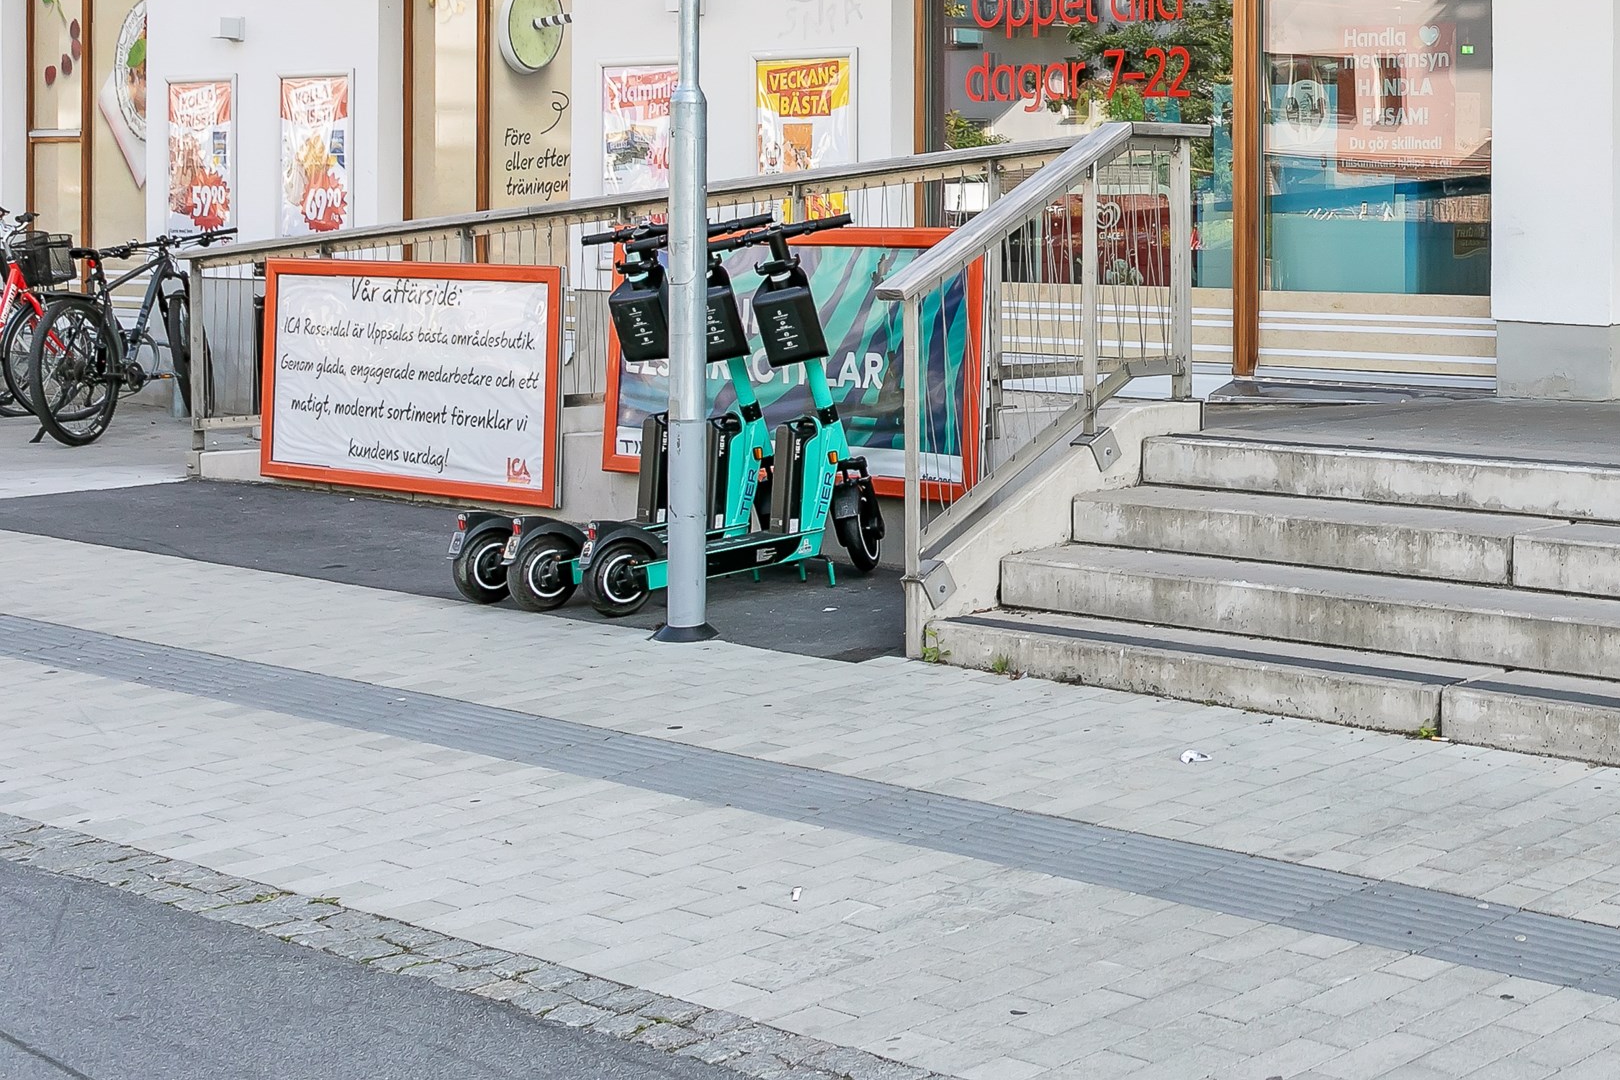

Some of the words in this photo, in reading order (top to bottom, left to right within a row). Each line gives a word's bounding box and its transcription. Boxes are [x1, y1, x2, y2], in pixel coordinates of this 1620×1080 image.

[1343, 27, 1407, 49] Handla
[1343, 49, 1383, 70] med
[1386, 47, 1450, 72] hänsyn
[769, 65, 839, 91] VECKANS
[964, 51, 1086, 113] dagar
[1358, 77, 1434, 97] HANDLA
[779, 92, 830, 116] BÄSTA
[504, 127, 532, 147] Före
[1349, 136, 1365, 150] Du
[1368, 136, 1389, 153] gör
[1391, 136, 1442, 150] skillnad!
[505, 150, 535, 172] eller
[536, 147, 571, 169] efter
[350, 277, 380, 303] Vår
[283, 316, 301, 334] ICA
[303, 317, 350, 337] Rosendal
[352, 323, 365, 339] är
[367, 321, 414, 346] Uppsalas
[418, 326, 449, 345] bästa
[451, 329, 536, 350] områdesbutik.
[280, 352, 315, 373] Genom
[316, 355, 347, 380] glada,
[350, 361, 416, 385] engagerade
[417, 364, 493, 387] medarbetare
[495, 370, 516, 389] och
[518, 371, 540, 390] ett
[290, 392, 331, 421] matigt,
[334, 397, 385, 419] modernt
[387, 401, 448, 425] sortiment
[450, 405, 514, 432] förenklar
[516, 414, 529, 432] vi
[347, 437, 400, 462] kundens
[402, 445, 450, 474] vardag!
[619, 438, 641, 455] TI
[718, 434, 727, 458] TIER
[794, 437, 802, 461] TIER
[507, 457, 530, 478] ICA
[739, 468, 758, 517] TIER
[816, 471, 834, 520] TIER
